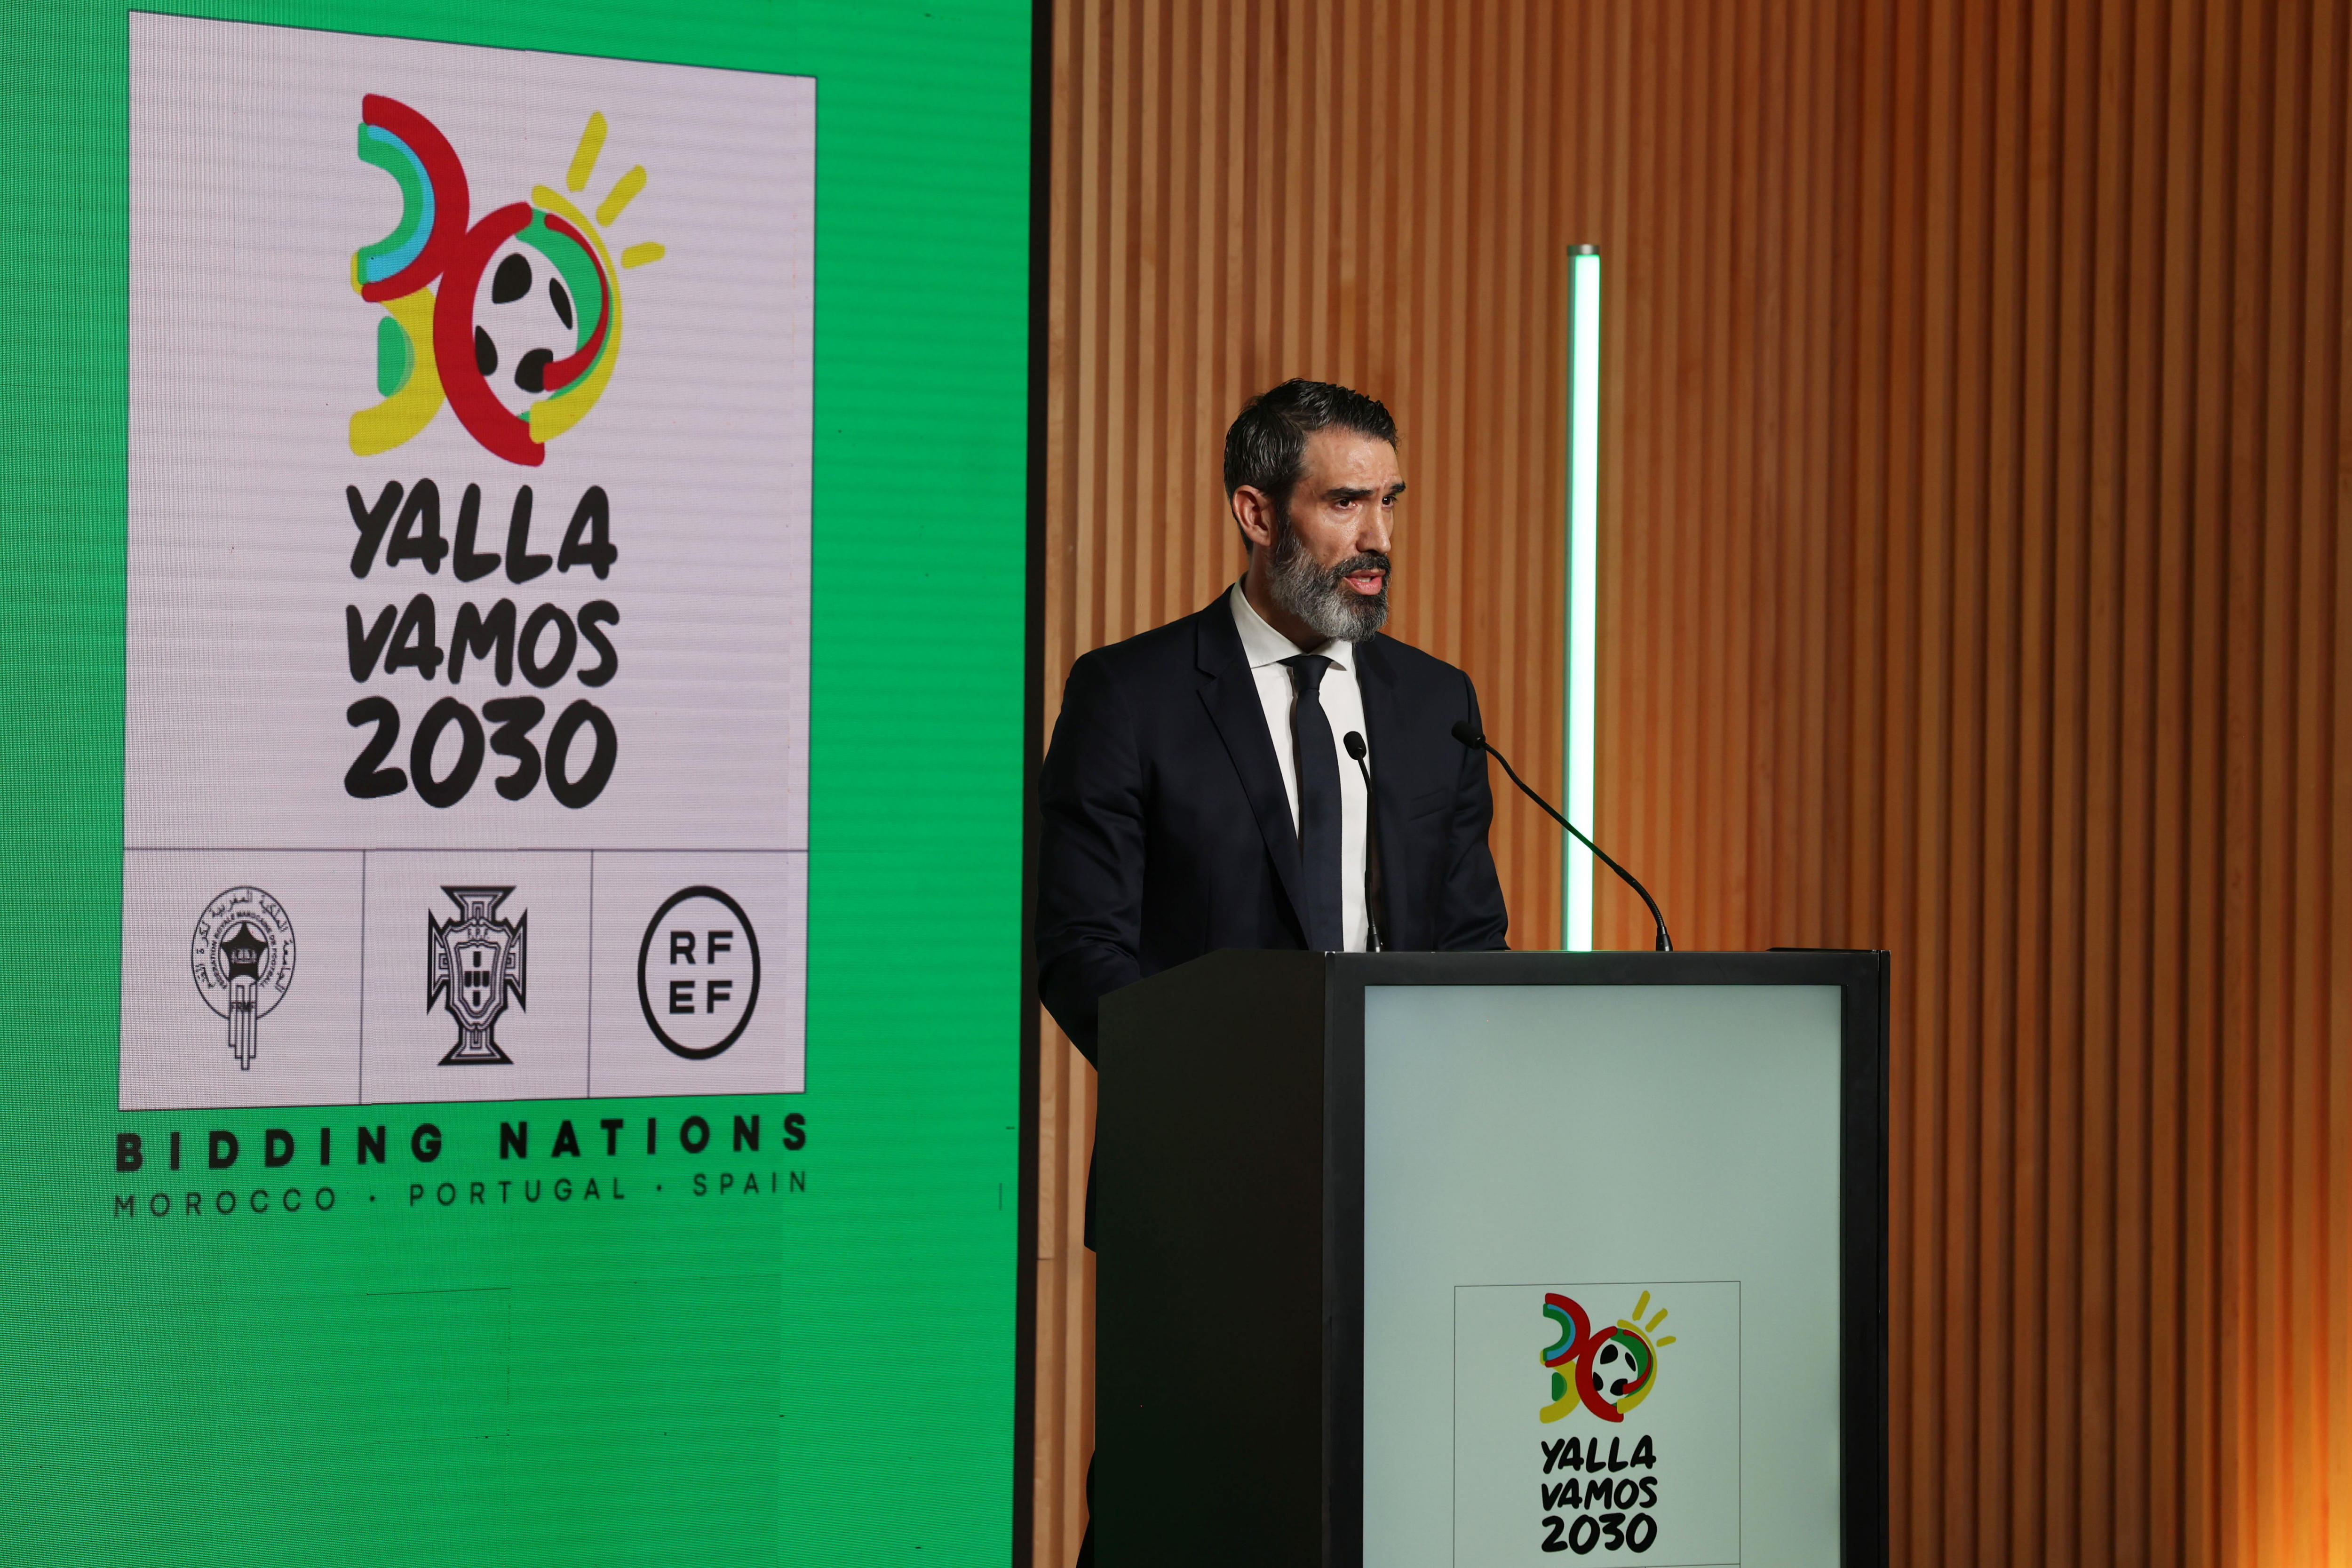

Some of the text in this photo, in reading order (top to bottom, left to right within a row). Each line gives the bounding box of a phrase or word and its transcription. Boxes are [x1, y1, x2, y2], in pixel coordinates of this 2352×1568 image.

[346, 478, 618, 584] YALLA
[346, 593, 620, 688] VAMOS
[344, 696, 618, 809] 2030
[115, 1113, 806, 1173] BIDDING NATIONS
[114, 1170, 805, 1218] MOROCCO PORTUGAL SPAIN
[1541, 1435, 1656, 1474] YALLA
[1542, 1476, 1658, 1511] VAMOS
[1541, 1512, 1657, 1555] 2030
